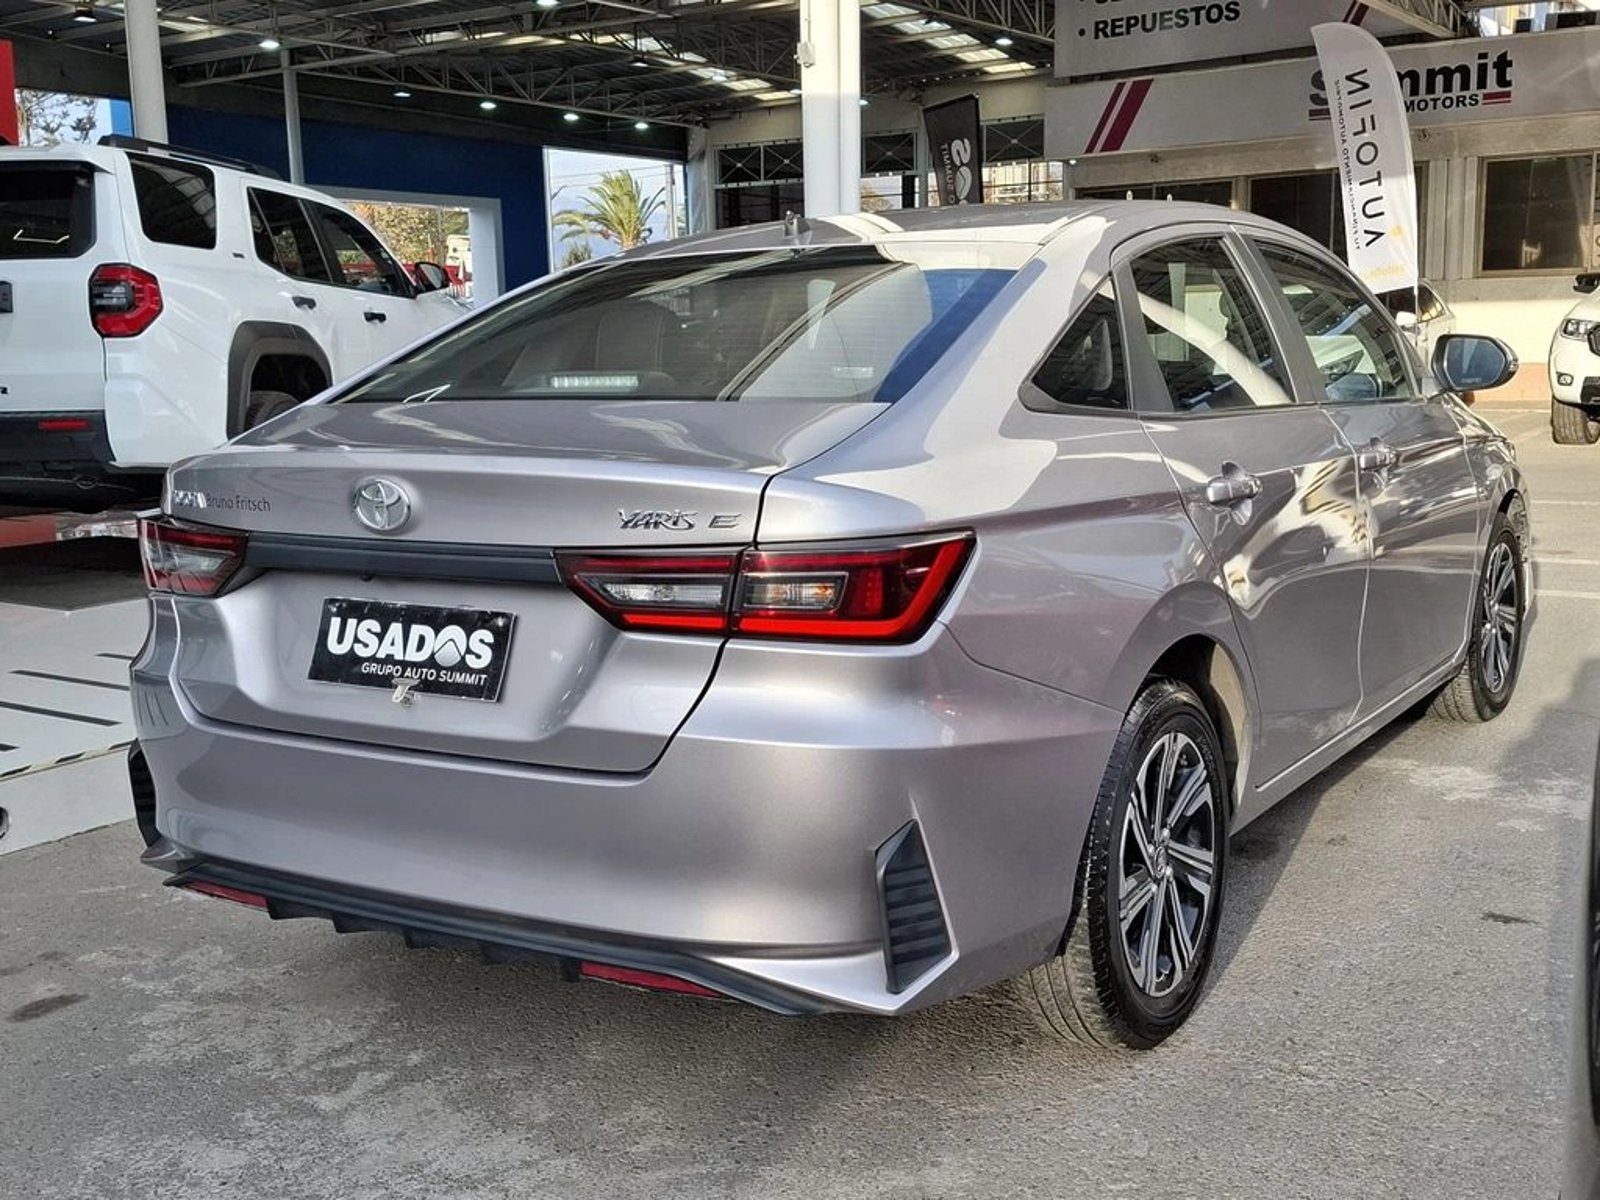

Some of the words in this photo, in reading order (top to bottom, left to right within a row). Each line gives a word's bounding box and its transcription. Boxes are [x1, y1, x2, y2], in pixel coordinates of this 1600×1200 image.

[1093, 1, 1241, 40] REPUESTOS
[1403, 93, 1480, 113] MOTORS
[236, 494, 271, 512] Fritsch
[708, 513, 742, 529] E
[327, 616, 495, 669] USADOS
[360, 661, 402, 677] GRUPO
[403, 666, 437, 681] AUTO
[438, 670, 488, 686] SUMMIT
